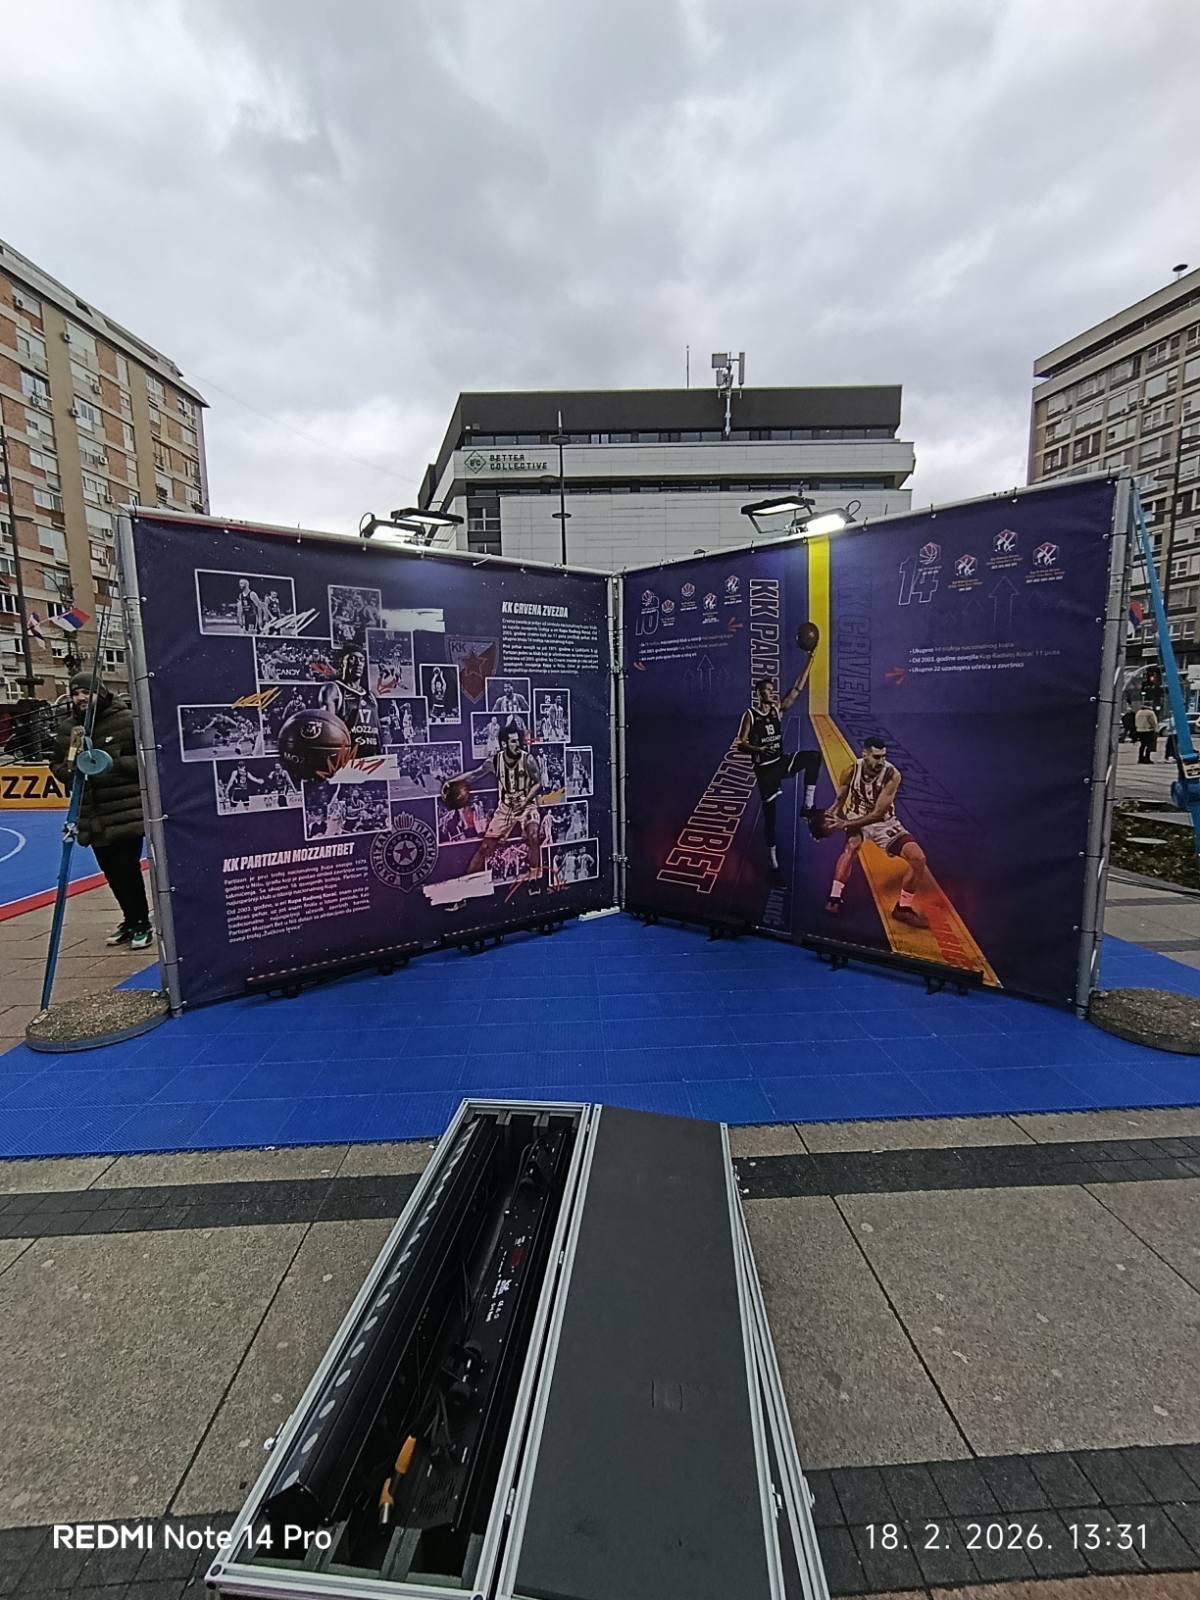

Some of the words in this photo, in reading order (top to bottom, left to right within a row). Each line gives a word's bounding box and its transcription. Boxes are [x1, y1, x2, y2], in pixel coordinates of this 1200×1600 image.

[490, 462, 547, 470] COLLECTIVE
[750, 579, 779, 618] KK
[502, 601, 514, 614] KK
[514, 602, 542, 616] CRVENA
[542, 606, 569, 618] ZVEZDA
[358, 708, 372, 724] 17
[0, 776, 72, 798] ZZA
[222, 858, 240, 872] KK
[240, 851, 291, 870] PARTIZAN
[292, 842, 355, 863] MOZZARTBET
